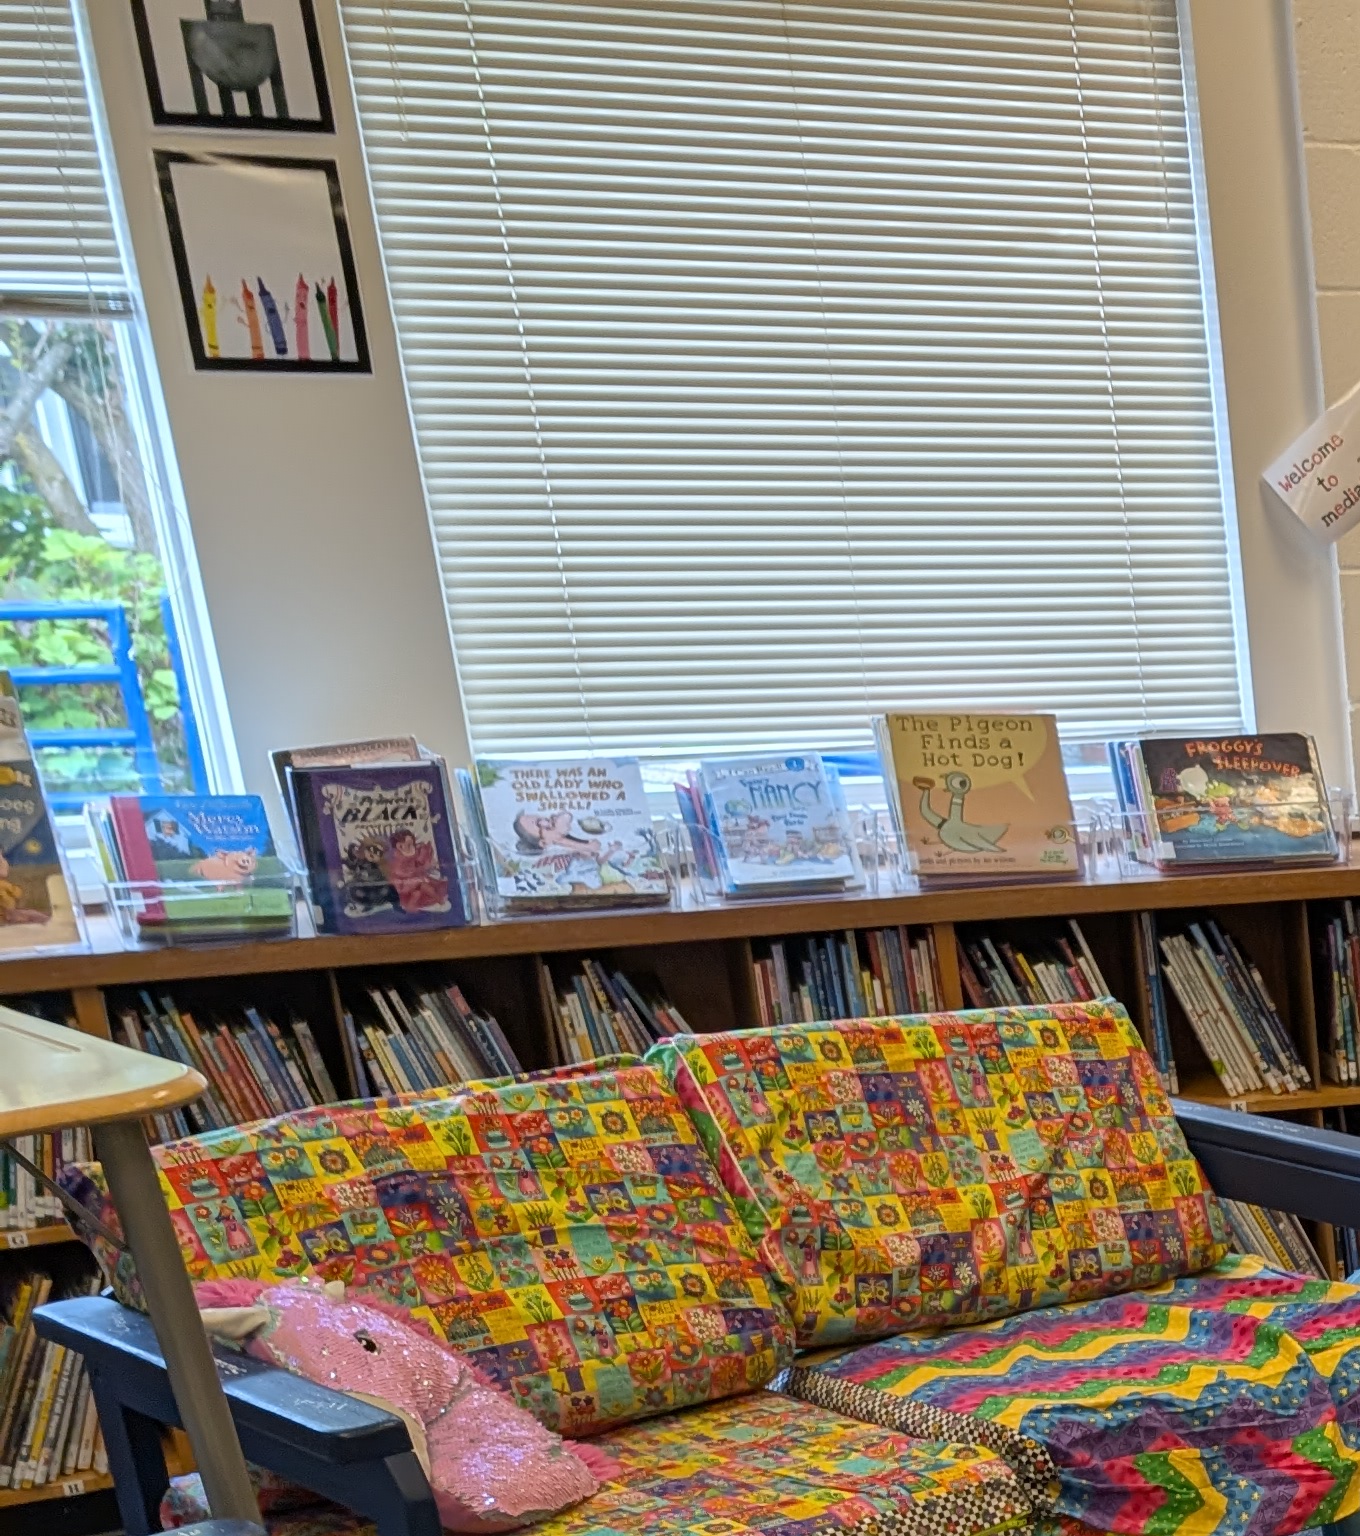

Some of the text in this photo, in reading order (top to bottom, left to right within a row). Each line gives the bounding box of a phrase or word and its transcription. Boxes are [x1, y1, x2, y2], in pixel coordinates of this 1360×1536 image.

[1278, 432, 1344, 493] Welcome
[1317, 473, 1339, 493] to
[895, 716, 1033, 734] The Pigeon
[921, 735, 1012, 750] Finds a
[1184, 738, 1264, 757] FROGGY'S
[922, 751, 1025, 769] Hot Dog!
[1212, 756, 1300, 778] SLEEPOVER
[511, 767, 607, 780] THERE WAS AN
[511, 779, 624, 790] OLD LADY WHO
[515, 791, 626, 803] SWALLOWED A
[750, 781, 822, 809] NANCY
[341, 805, 418, 823] BLACK
[537, 801, 592, 812] SHELL!
[1234, 1102, 1244, 1112] K
